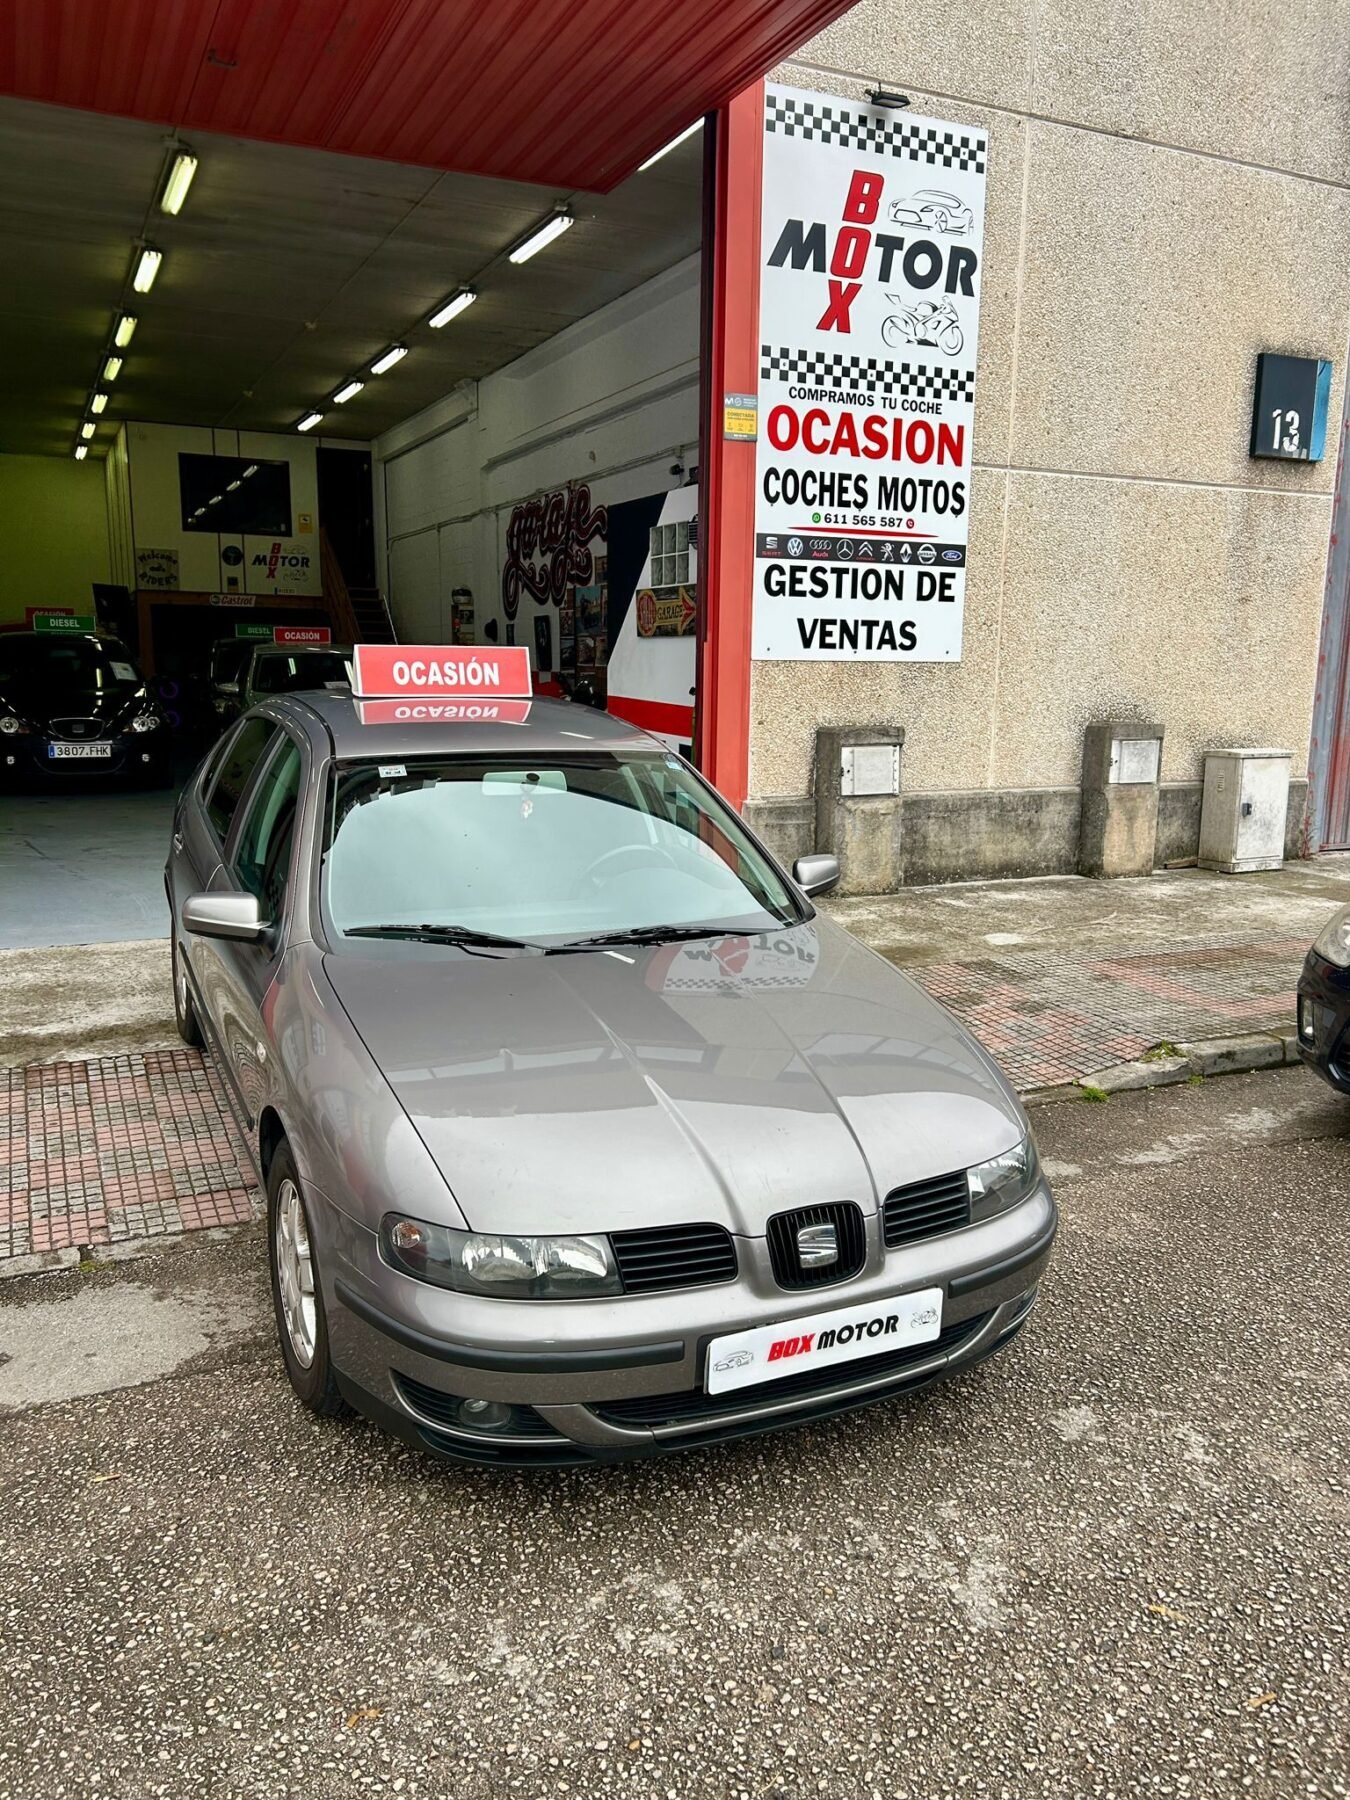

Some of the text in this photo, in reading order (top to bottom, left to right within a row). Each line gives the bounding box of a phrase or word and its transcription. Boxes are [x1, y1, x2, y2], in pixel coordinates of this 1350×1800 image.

[766, 218, 979, 298] MOTOR
[815, 169, 885, 334] BOX
[788, 386, 943, 415] COMPRAMOS TU COCHE
[766, 404, 965, 467] OCASION
[1272, 408, 1300, 452] 13
[763, 467, 966, 516] COCHES MOTOS
[824, 513, 903, 528] 611 565 587
[137, 550, 178, 564] Welcome
[138, 571, 177, 585] RIDERS
[763, 564, 957, 602] GESTION DE
[49, 618, 81, 628] DIESEL
[657, 604, 684, 620] GARAGE
[284, 631, 321, 640] OCASIÓN
[796, 617, 918, 651] VENTAS
[392, 656, 500, 687] OCASIÓN
[767, 1314, 900, 1362] BOX MOTOR
